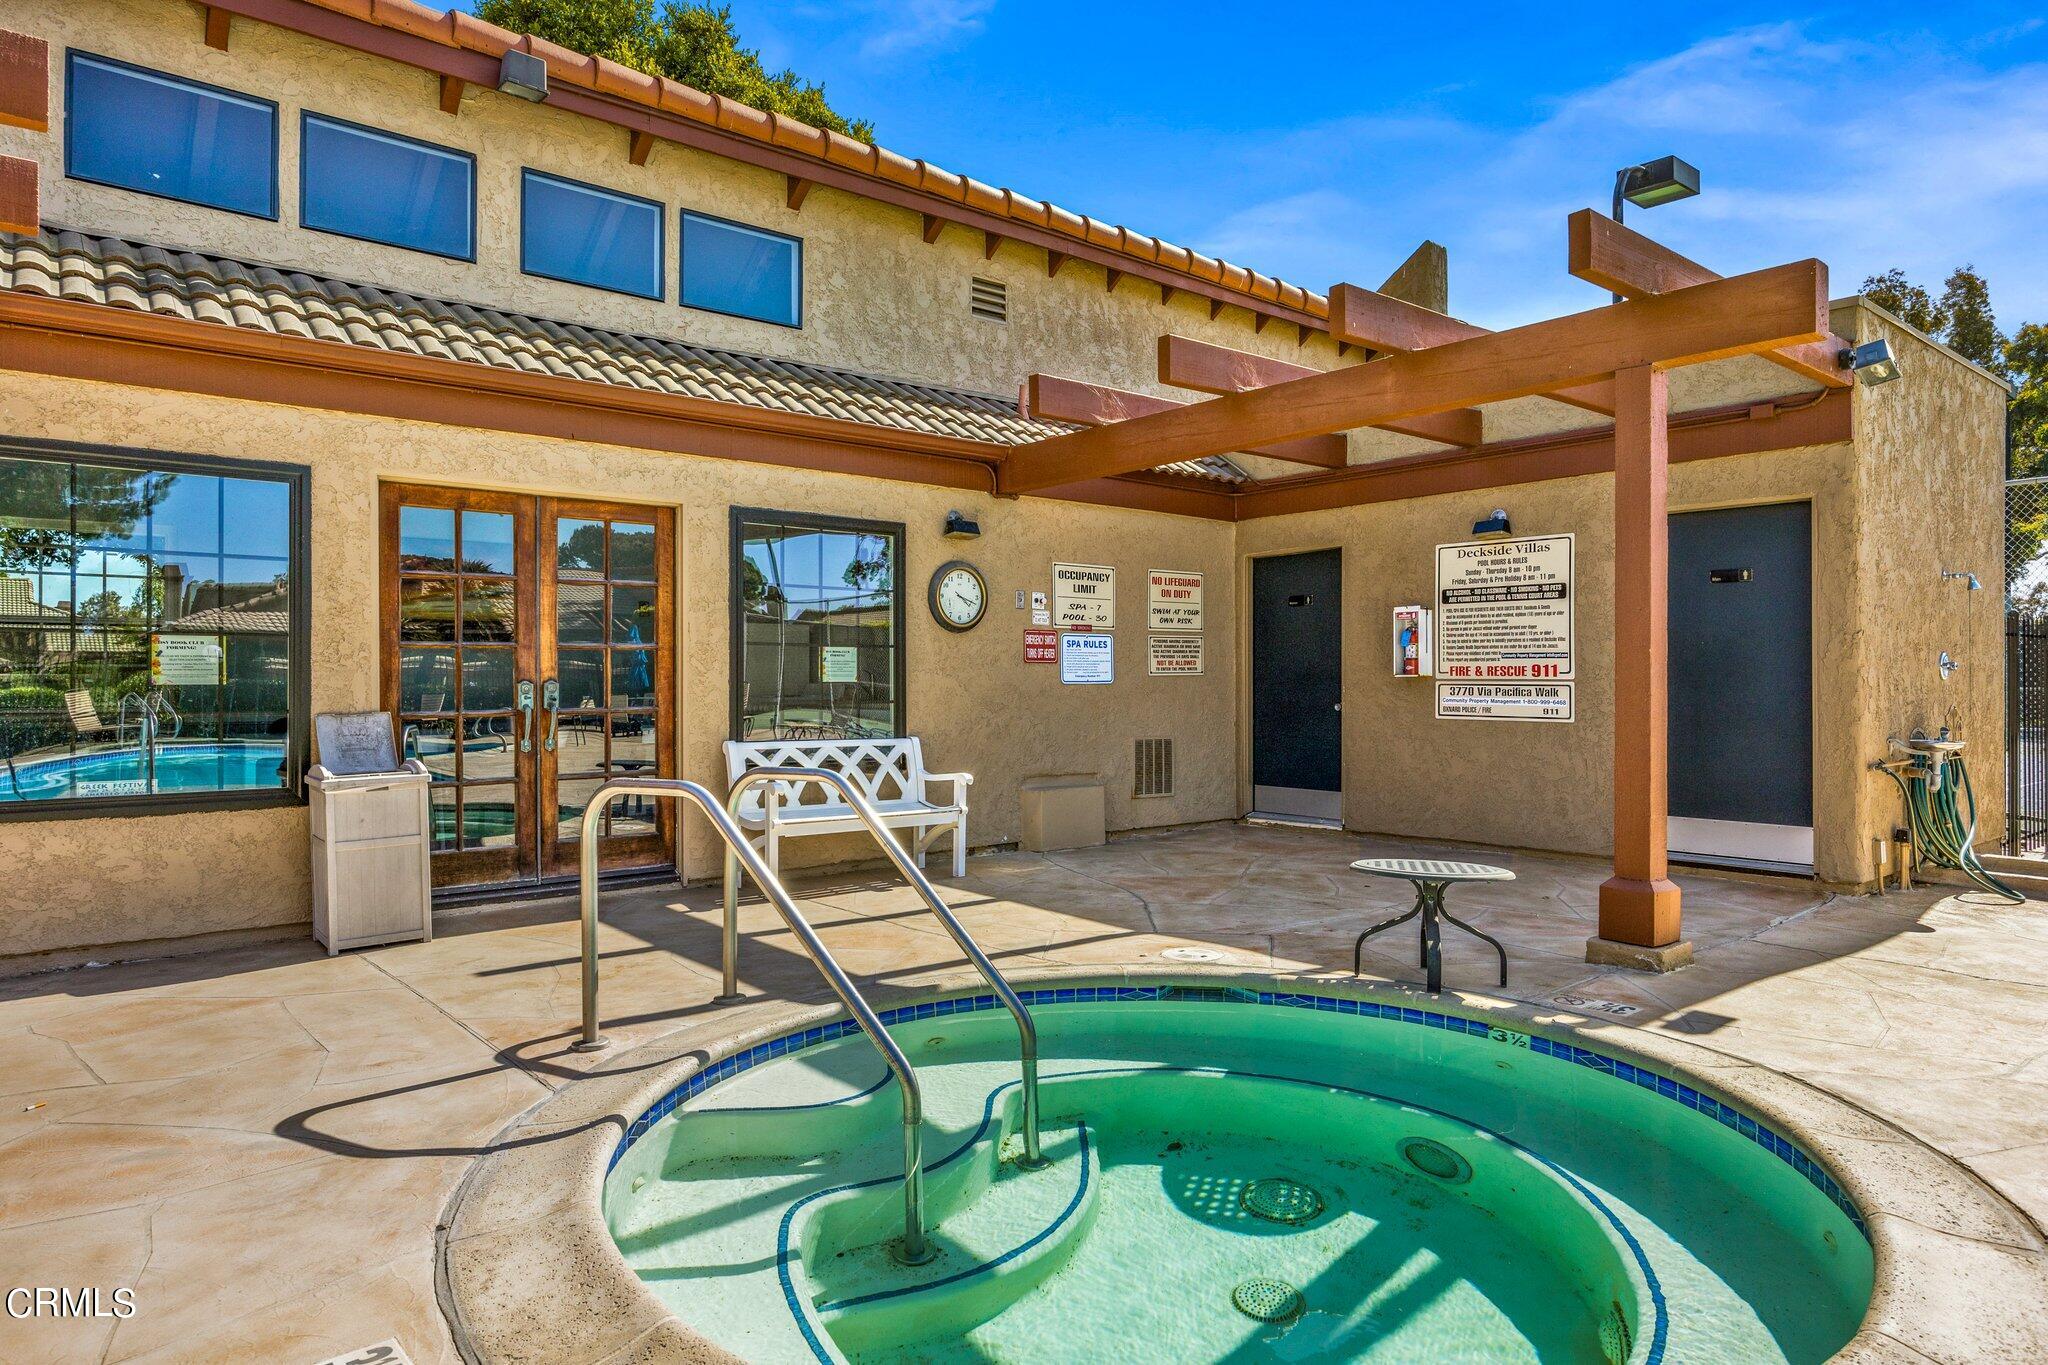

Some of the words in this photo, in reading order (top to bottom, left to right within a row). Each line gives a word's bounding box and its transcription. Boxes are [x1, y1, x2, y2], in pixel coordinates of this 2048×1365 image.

[1457, 546, 1512, 558] Deckside
[1516, 543, 1550, 554] Villas
[1058, 570, 1110, 582] OCCUPANCY
[1152, 577, 1162, 585] NO
[1165, 578, 1200, 587] LIFEGUARD
[1073, 584, 1097, 594] LIMIT
[1161, 589, 1171, 597] ON
[1174, 590, 1191, 598] DUTY
[1450, 666, 1471, 677] FIRE
[1475, 666, 1483, 676] &
[1487, 666, 1527, 676] RESCUE
[1532, 664, 1557, 677] 911
[1450, 687, 1474, 696] 3770
[1478, 687, 1492, 696] Via
[1496, 687, 1532, 697] Pacifica
[1535, 688, 1559, 697] Walk
